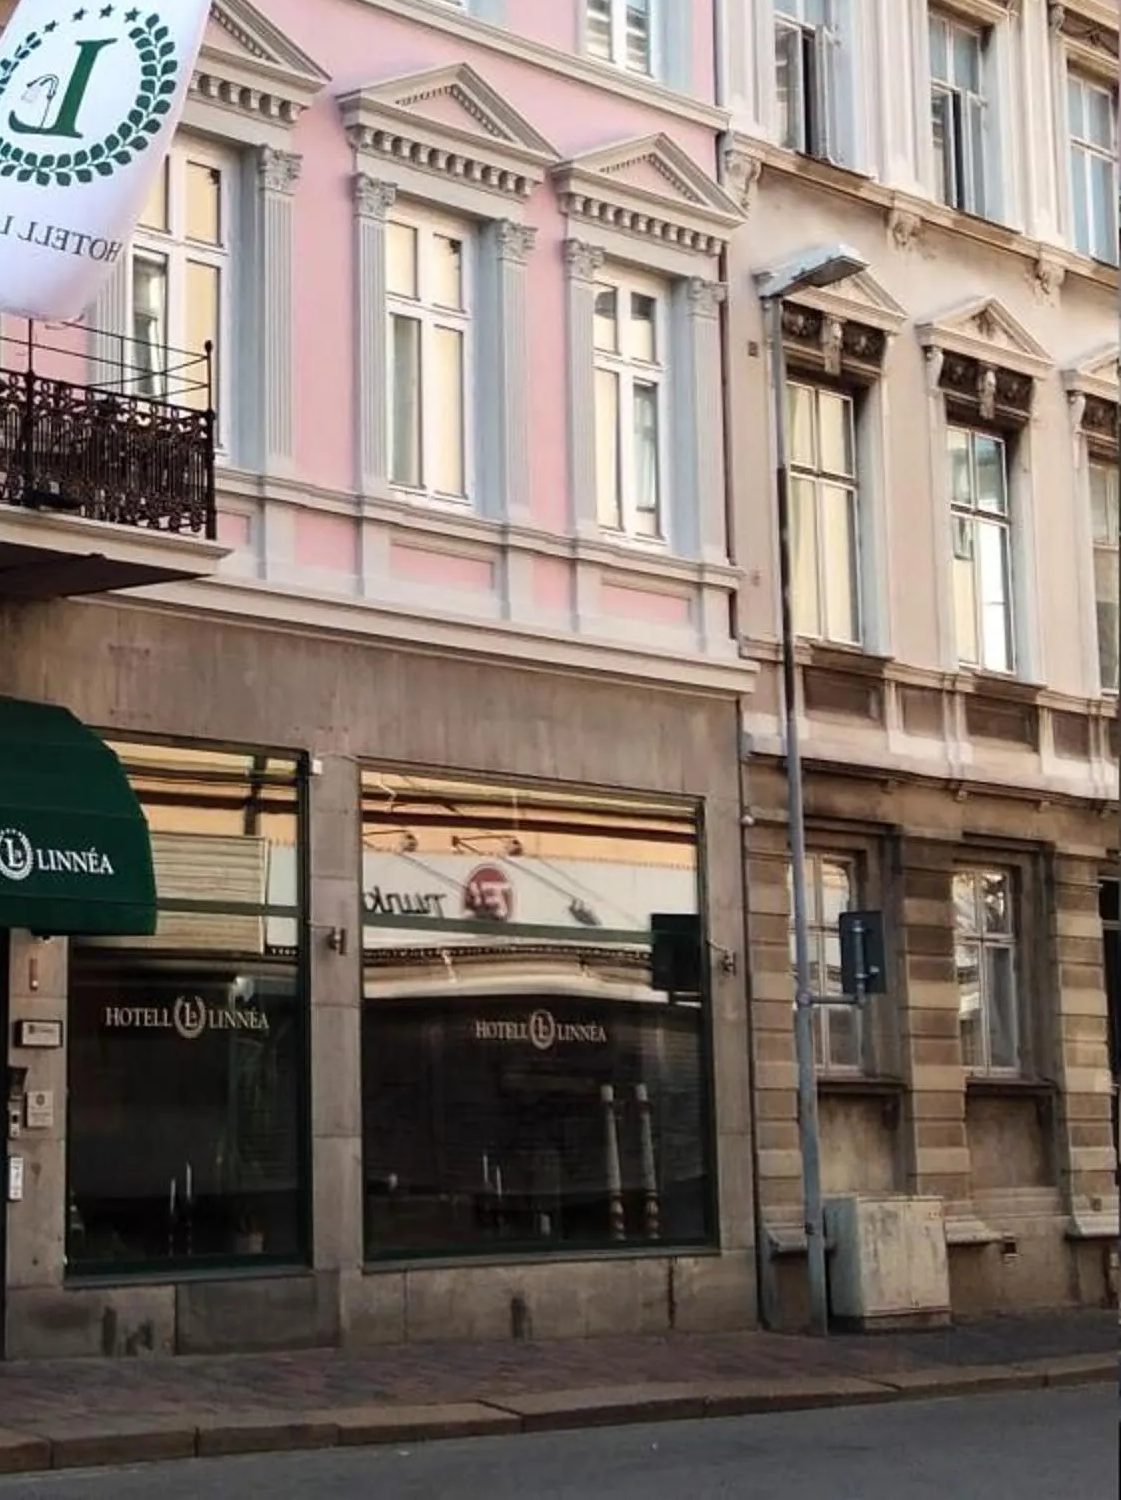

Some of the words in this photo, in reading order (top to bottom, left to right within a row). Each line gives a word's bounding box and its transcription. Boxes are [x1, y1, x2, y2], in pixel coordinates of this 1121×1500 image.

[36, 847, 115, 875] LINNÉA
[105, 1007, 172, 1027] HOTELL
[208, 1007, 270, 1029] LINNÉA
[476, 1020, 528, 1039] HOTELL
[556, 1021, 607, 1042] LINNÉA
